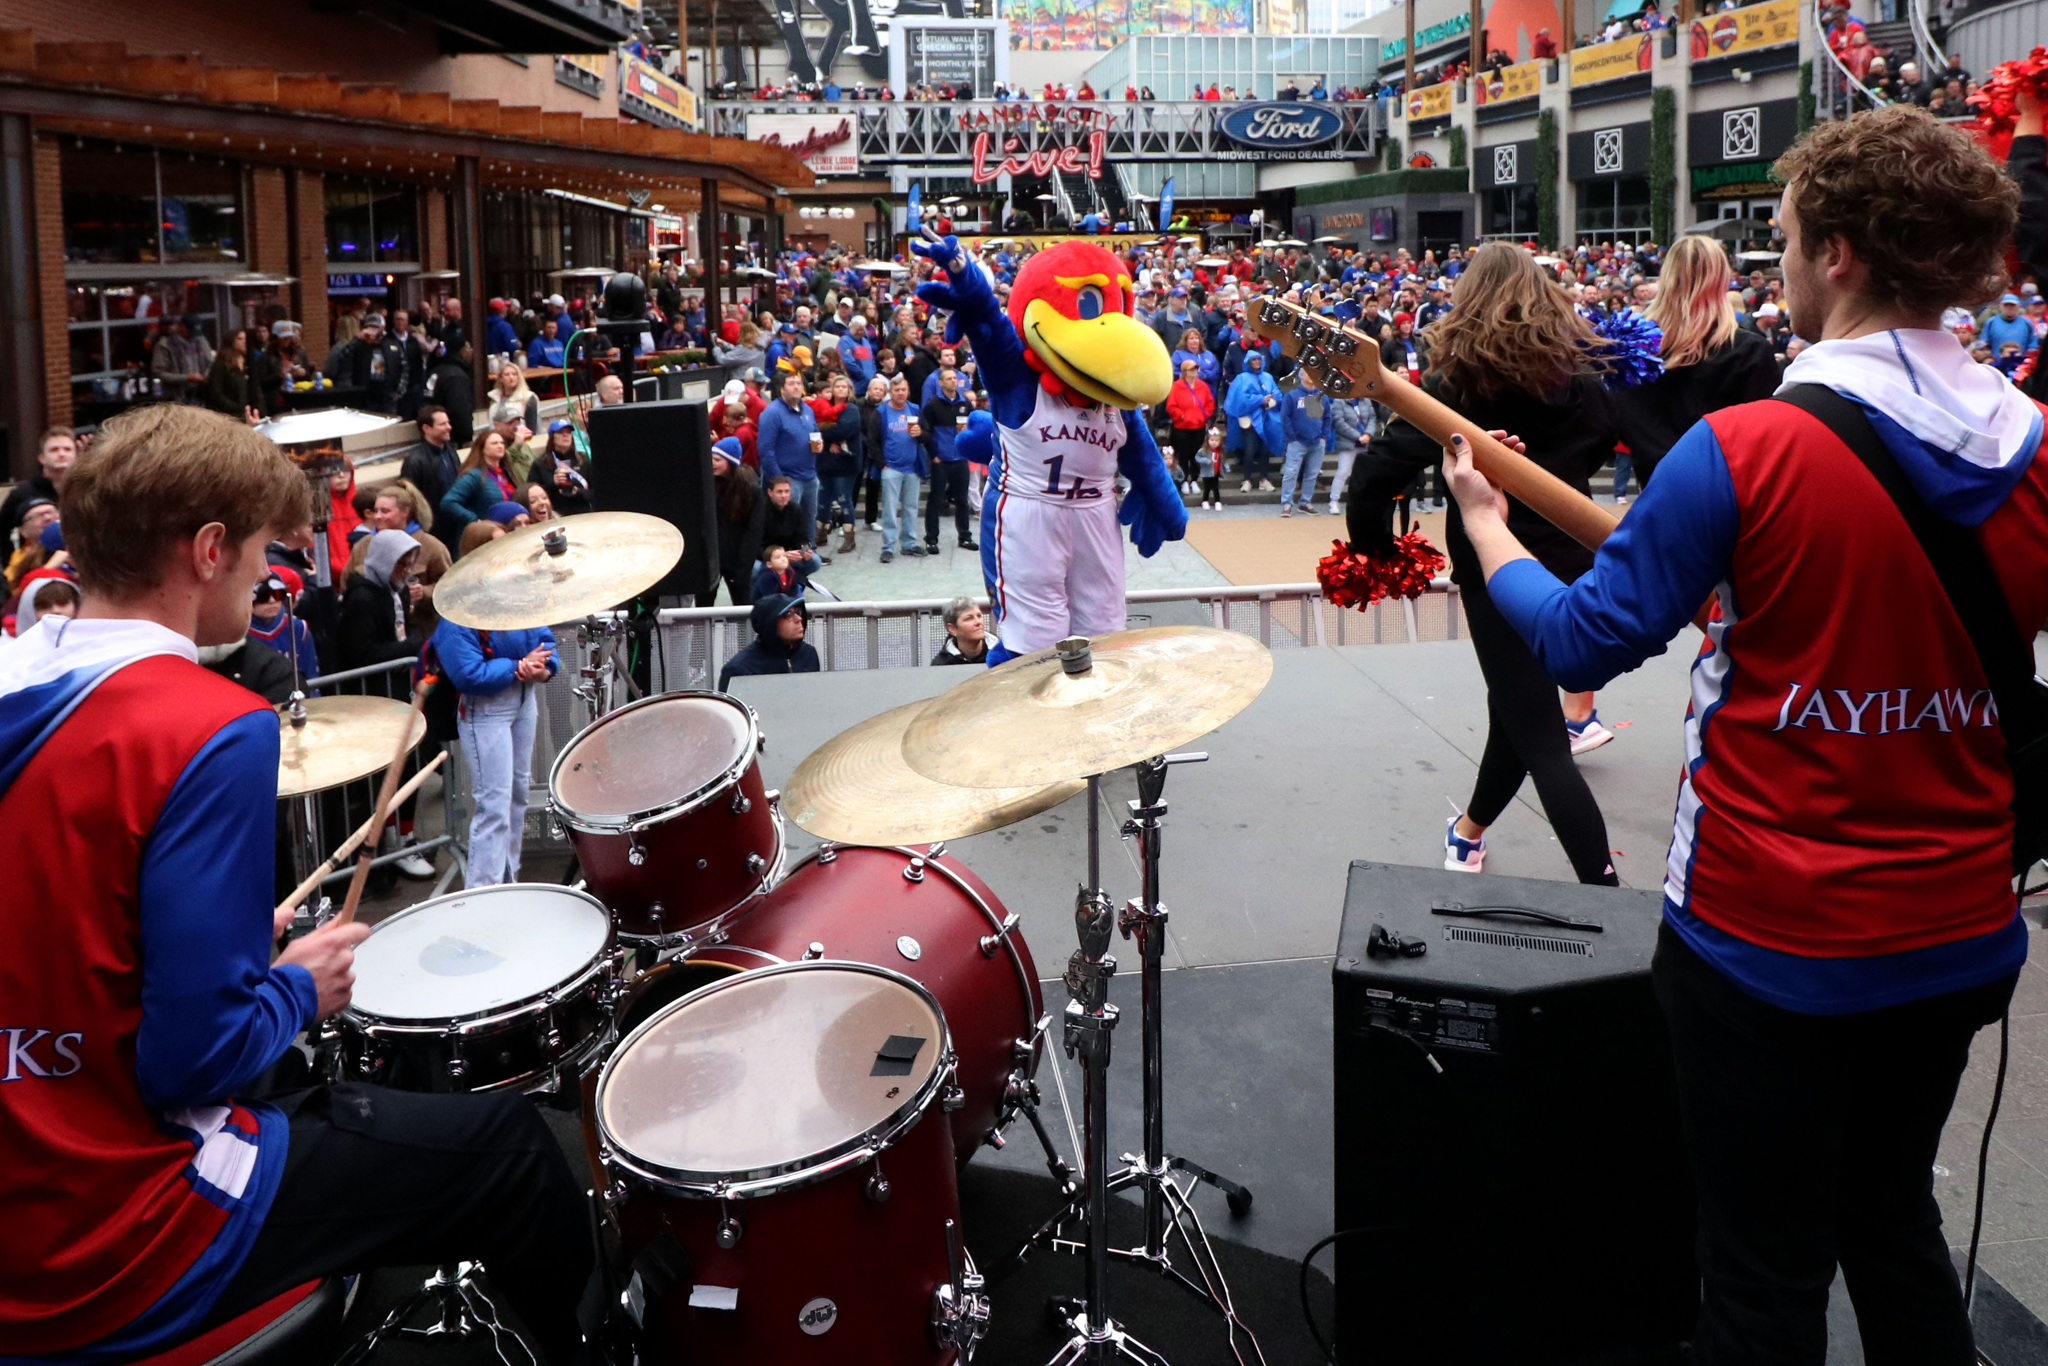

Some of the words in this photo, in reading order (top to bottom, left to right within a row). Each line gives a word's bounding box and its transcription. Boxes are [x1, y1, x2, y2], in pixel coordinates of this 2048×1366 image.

[915, 35, 951, 43] VRTUAL
[951, 35, 984, 43] WALLT
[957, 103, 1059, 131] KANSAS
[1065, 105, 1118, 131] CITY
[1246, 107, 1322, 139] Ford
[811, 156, 834, 164] LEINIE
[835, 156, 857, 164] LODGE
[971, 129, 1106, 184] Live!
[1217, 150, 1266, 160] MIDWEST
[1267, 150, 1296, 160] FORD
[1297, 150, 1344, 159] DEALERS
[1039, 424, 1117, 452] KANSAS
[1395, 996, 1435, 1007] Ampeg
[0, 1028, 83, 1081] KS
